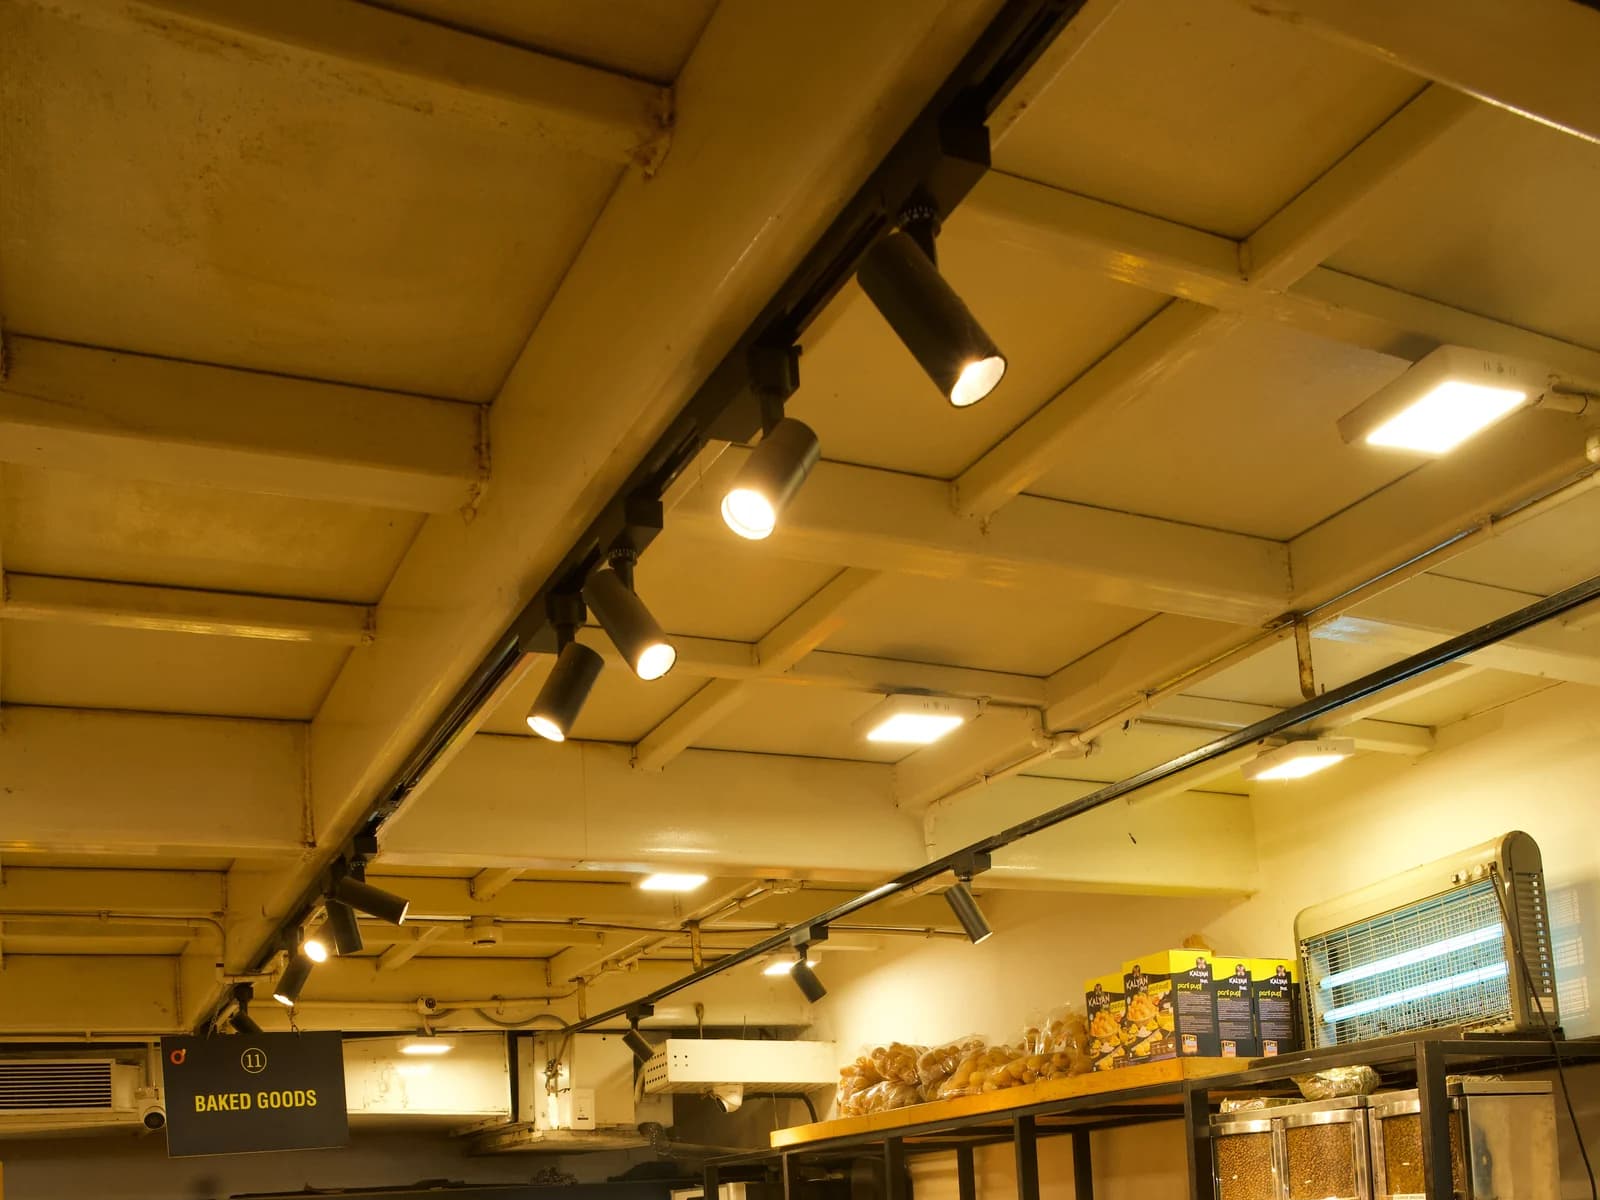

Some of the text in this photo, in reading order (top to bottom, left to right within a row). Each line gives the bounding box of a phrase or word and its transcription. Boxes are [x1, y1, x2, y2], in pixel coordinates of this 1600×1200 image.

[1126, 975, 1148, 990] KALYAN
[246, 1054, 262, 1068] 11
[195, 1089, 318, 1112] BAKED GOODS
